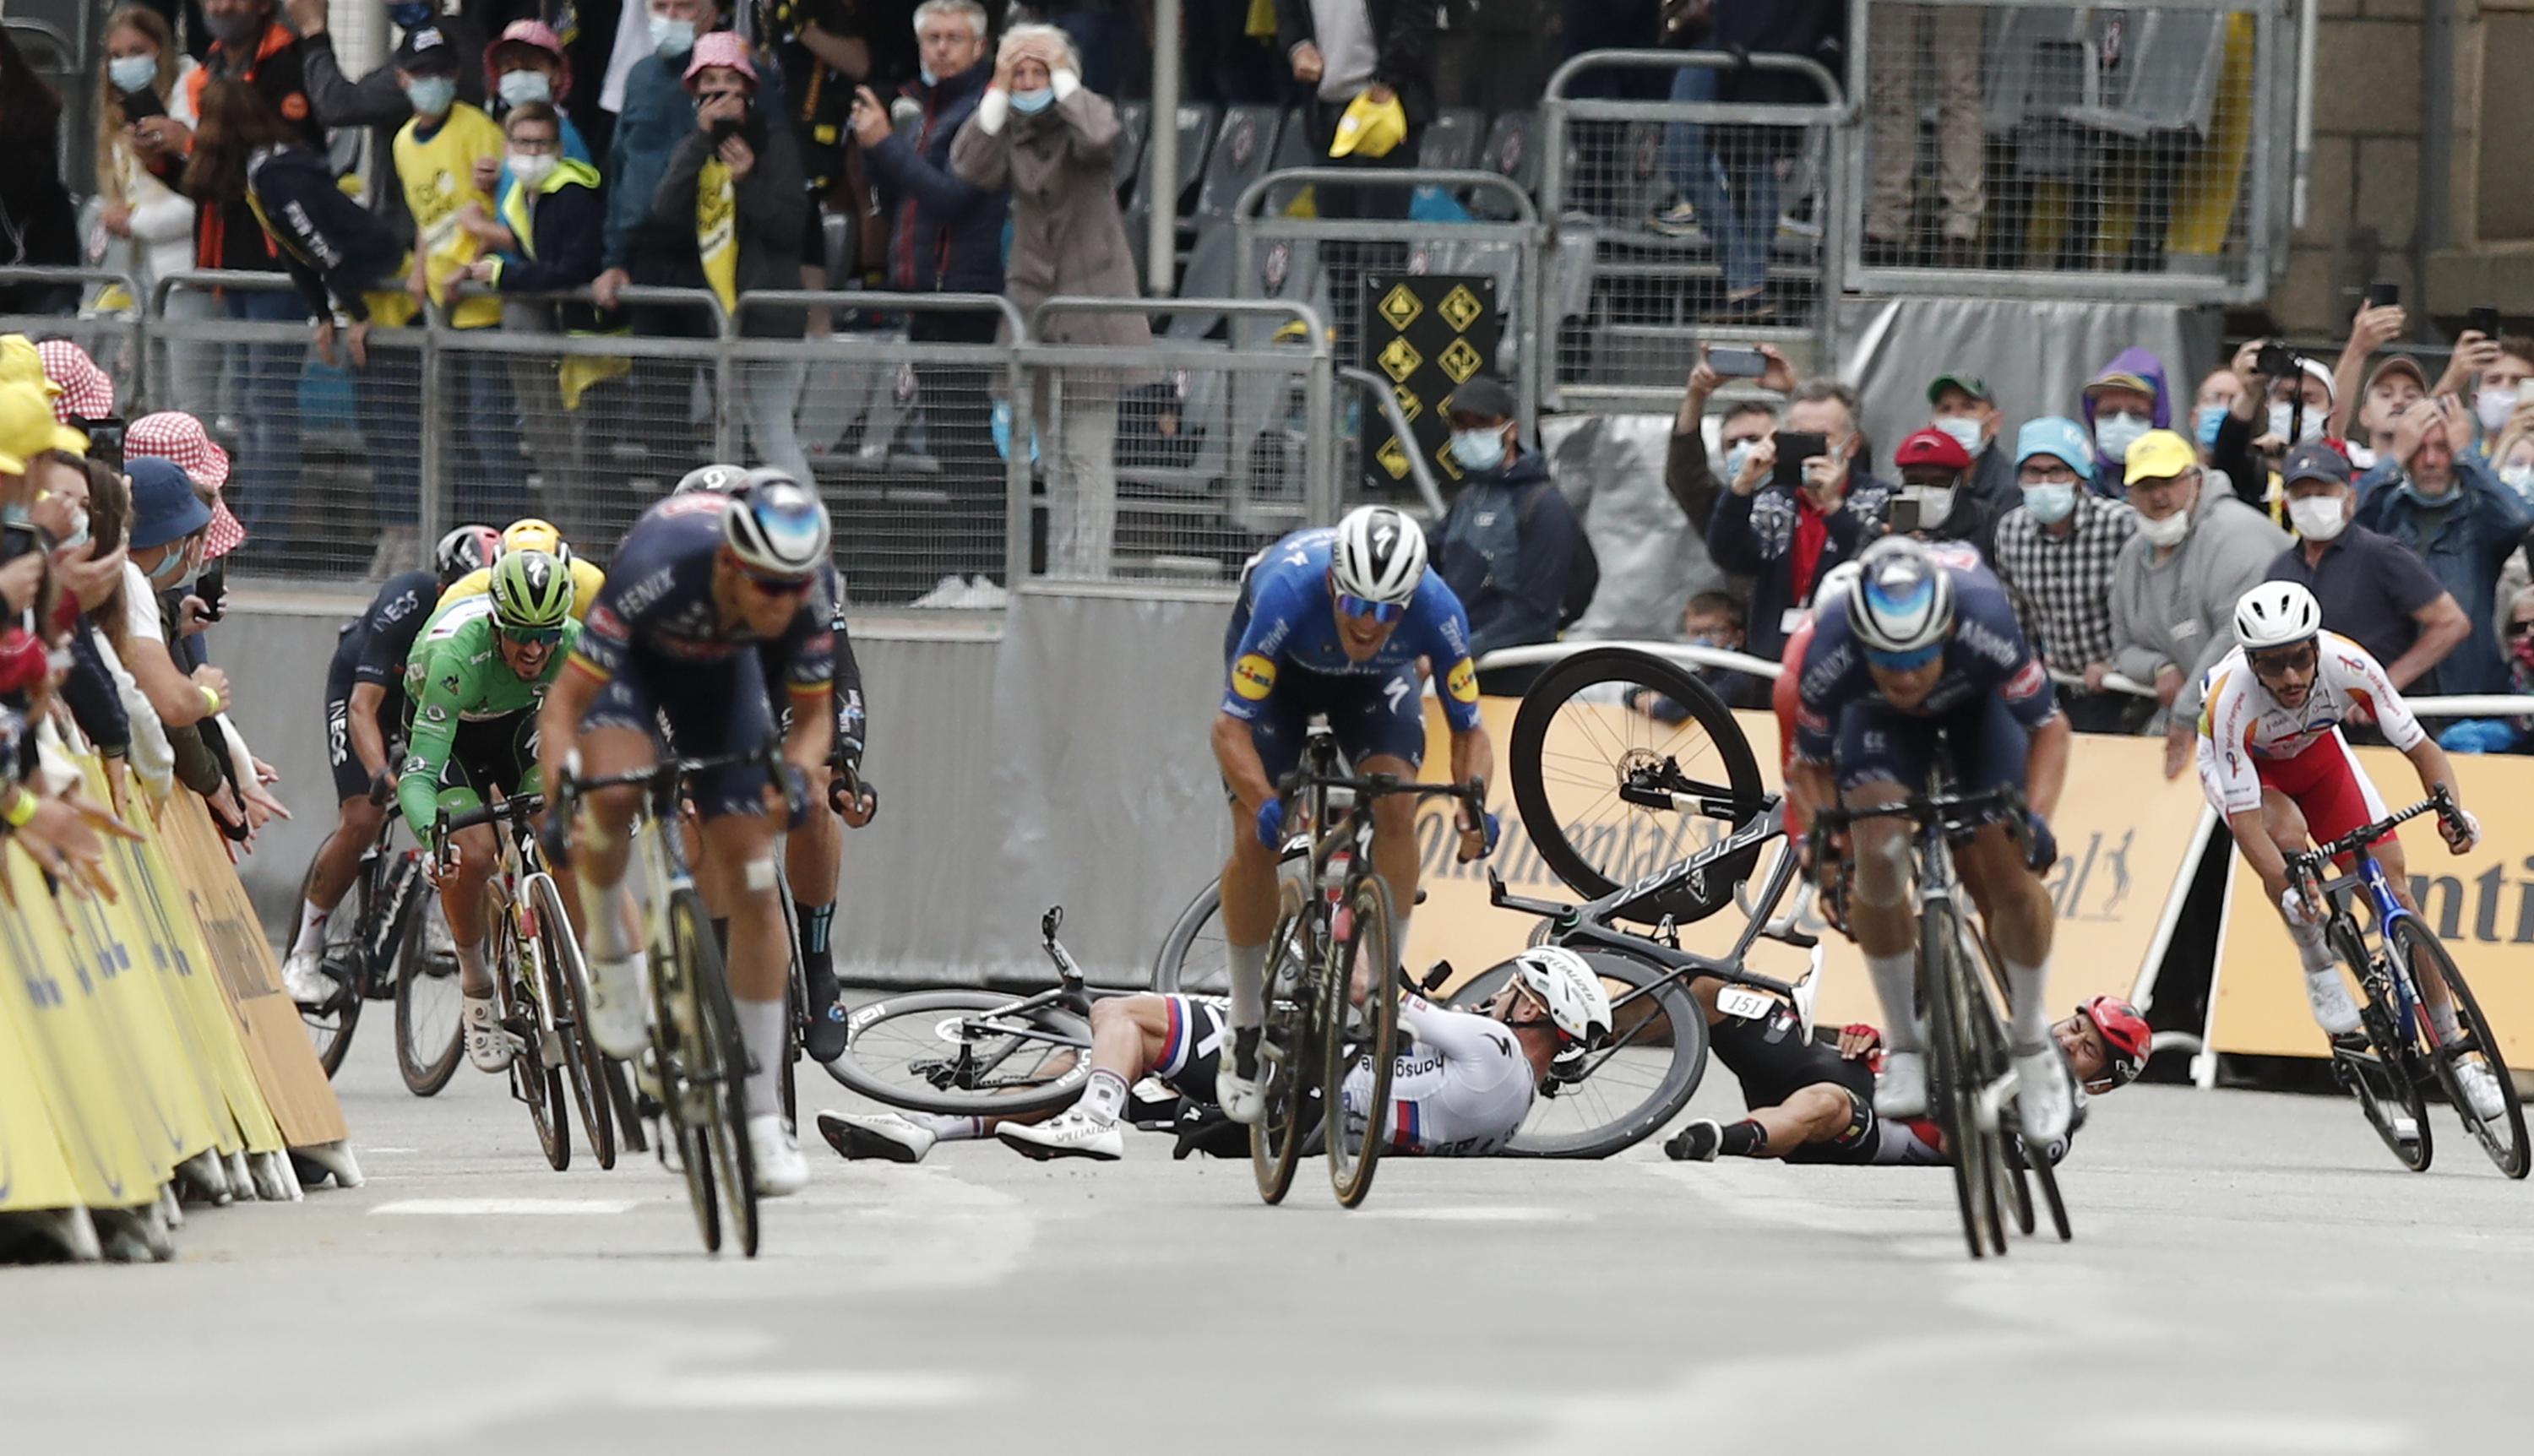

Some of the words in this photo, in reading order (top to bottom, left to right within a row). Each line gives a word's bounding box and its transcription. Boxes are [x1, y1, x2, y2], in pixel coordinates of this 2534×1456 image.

[372, 589, 419, 633] INEOS
[617, 567, 676, 620] FENIX
[329, 698, 348, 767] INEOS
[1538, 953, 1596, 1002] SPECIALIZED
[1727, 994, 1763, 1016] 151
[1361, 1051, 1445, 1078] hansge
[1055, 1123, 1119, 1143] SPECIALIZED
